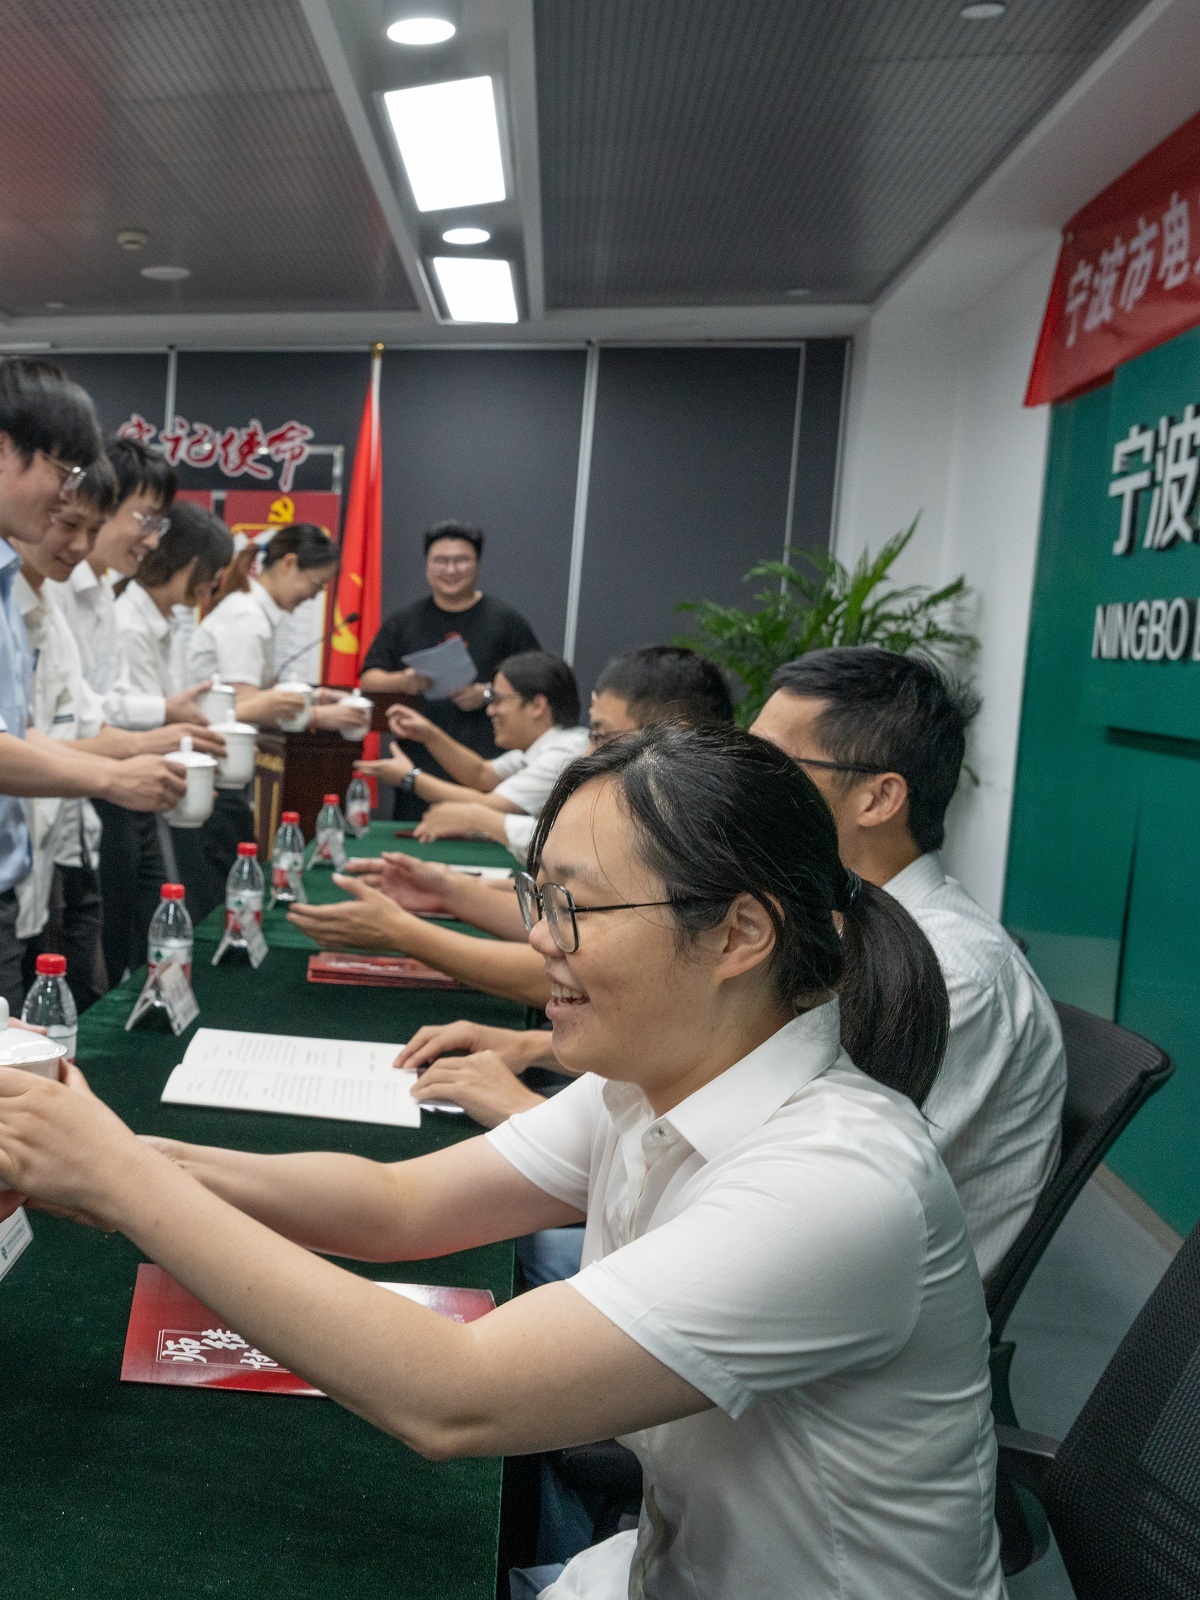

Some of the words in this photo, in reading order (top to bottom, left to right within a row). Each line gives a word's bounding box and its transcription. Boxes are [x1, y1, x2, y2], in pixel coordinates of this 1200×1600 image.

[1064, 190, 1200, 349] 宁波市电
[1091, 597, 1189, 661] NINGBO
